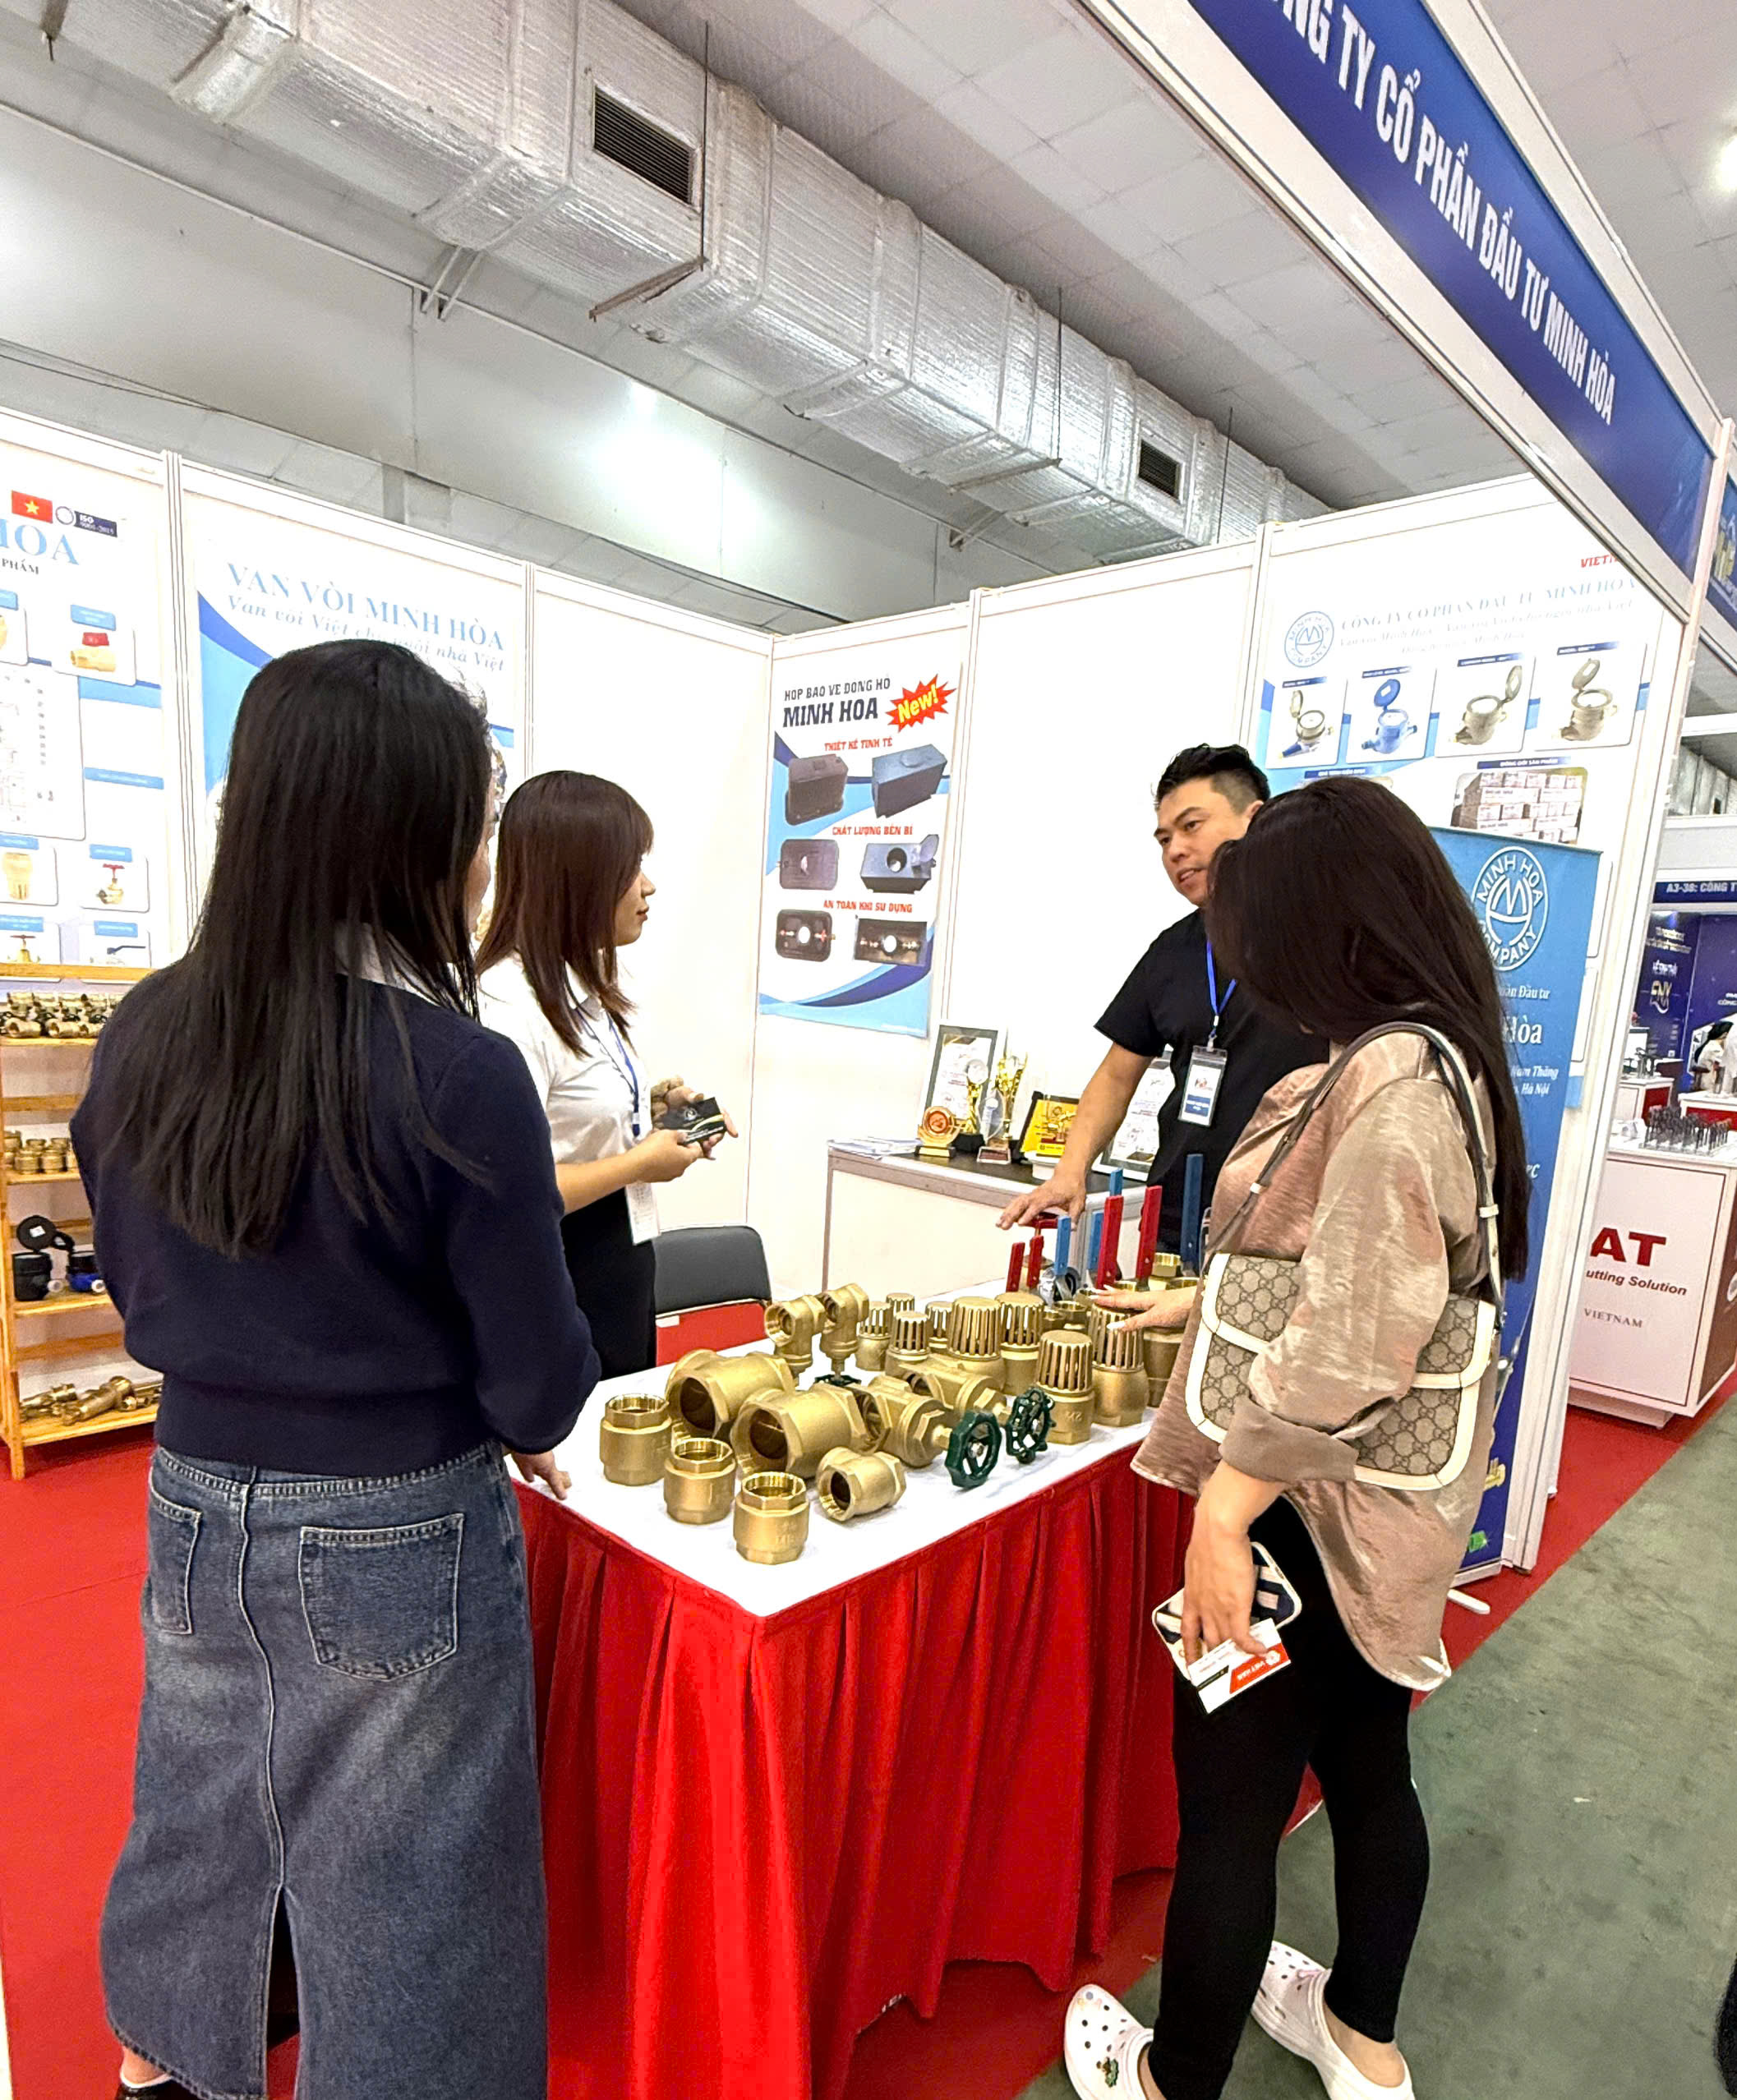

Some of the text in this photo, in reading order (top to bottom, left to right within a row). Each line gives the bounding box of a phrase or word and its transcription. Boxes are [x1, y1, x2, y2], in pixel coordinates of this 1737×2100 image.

[1338, 3, 1376, 111] TY
[1376, 63, 1421, 163] CỔ
[1543, 291, 1589, 389] MINH
[228, 594, 267, 618] Van
[228, 563, 504, 652] VAN VÒI MINH HÒA
[782, 702, 835, 729] MINH
[897, 684, 938, 723] New!
[1477, 854, 1517, 905] MINH
[1520, 858, 1545, 908] HOA
[823, 900, 834, 909] AN
[1586, 1269, 1688, 1296] utting Solution
[1583, 1307, 1643, 1329] VIETNAM
